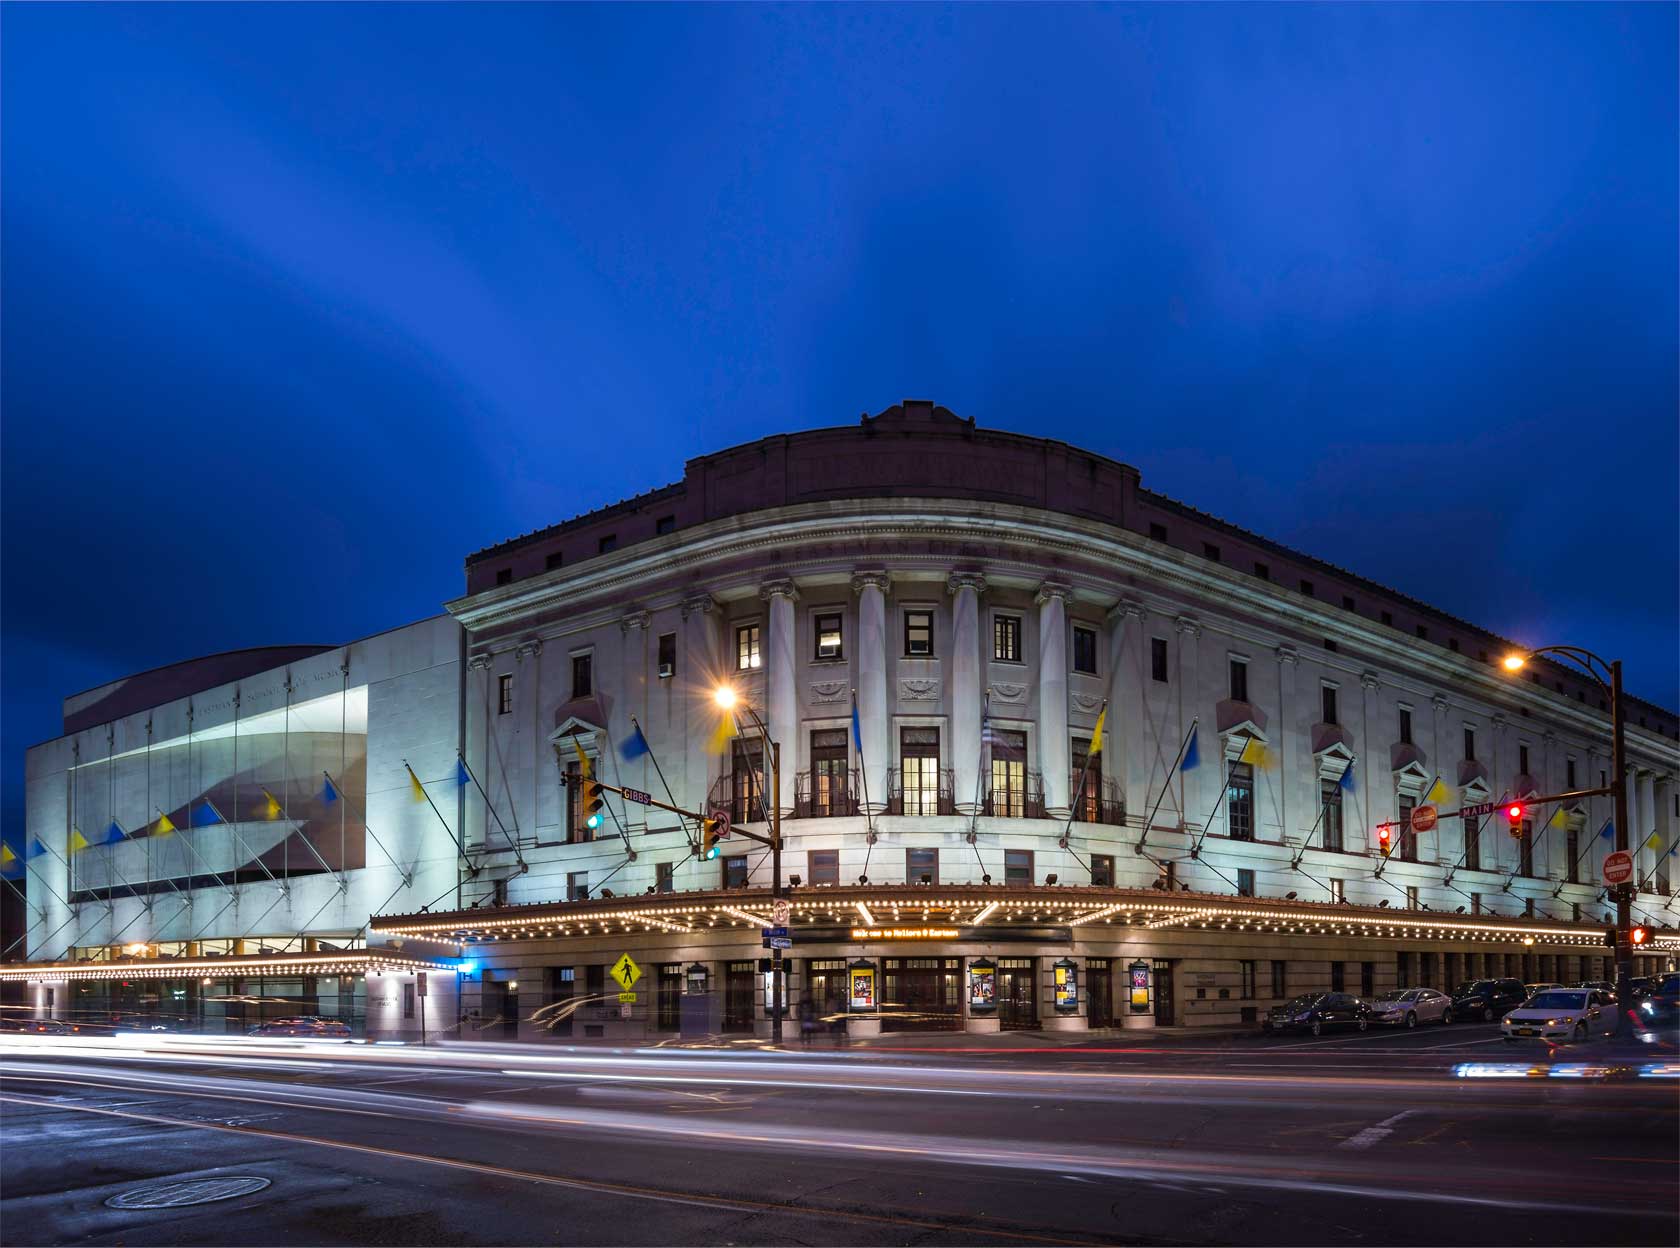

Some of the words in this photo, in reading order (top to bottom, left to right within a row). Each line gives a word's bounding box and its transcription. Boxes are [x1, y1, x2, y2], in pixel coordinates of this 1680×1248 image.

[624, 789, 649, 804] GIBBS
[1463, 804, 1490, 817] MAIN
[1609, 870, 1627, 879] ENTER
